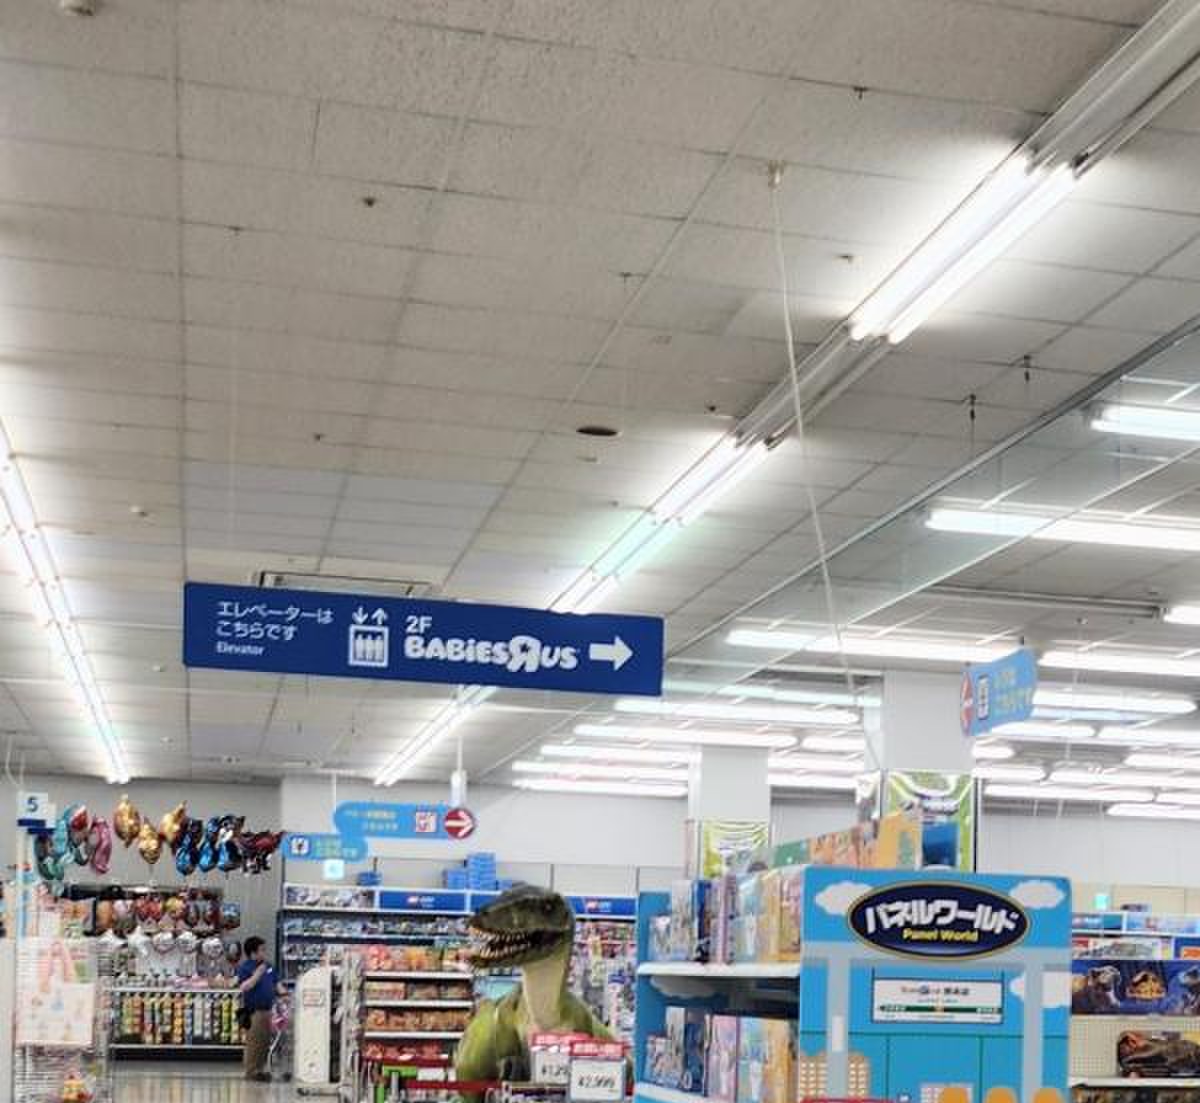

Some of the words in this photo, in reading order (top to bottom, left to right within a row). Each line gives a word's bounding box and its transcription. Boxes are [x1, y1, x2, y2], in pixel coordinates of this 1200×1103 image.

[217, 601, 335, 624] エレベーターは
[216, 620, 298, 640] こちらです
[405, 615, 432, 634] 2F
[27, 796, 38, 812] 5
[865, 899, 1020, 934] パネルワールド
[902, 928, 937, 941] Panel
[940, 929, 979, 942] World
